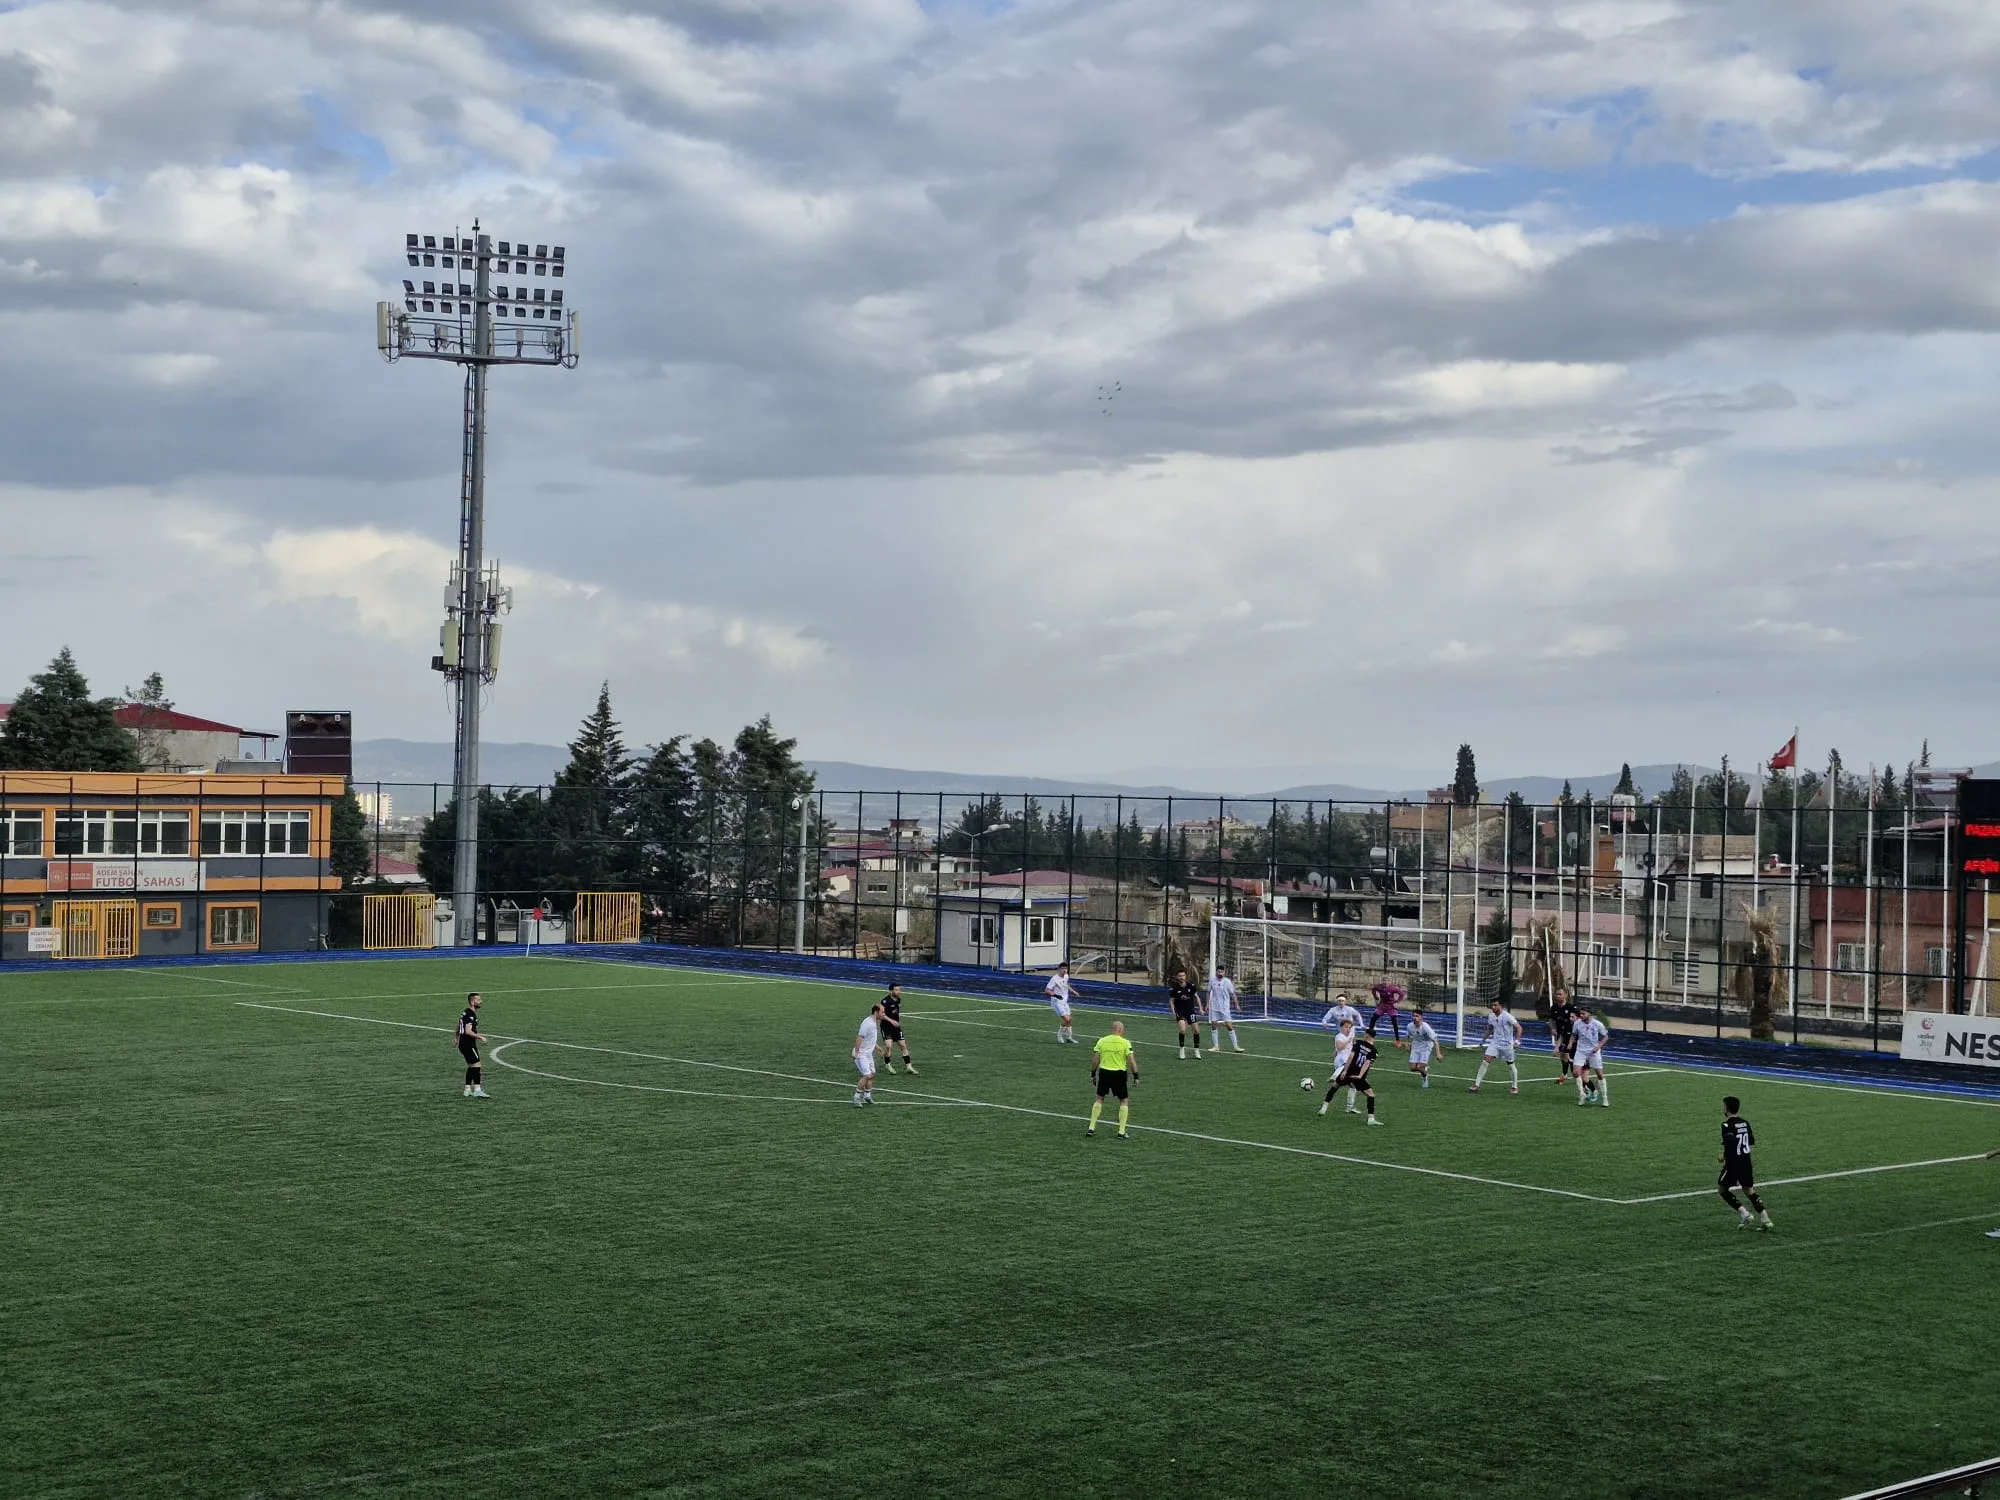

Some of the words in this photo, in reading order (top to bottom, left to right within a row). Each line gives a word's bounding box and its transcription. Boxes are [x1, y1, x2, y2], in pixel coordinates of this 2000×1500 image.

[143, 877, 185, 887] SAHASI
[1945, 1032, 2000, 1060] NES
[1736, 1133, 1750, 1155] 79
